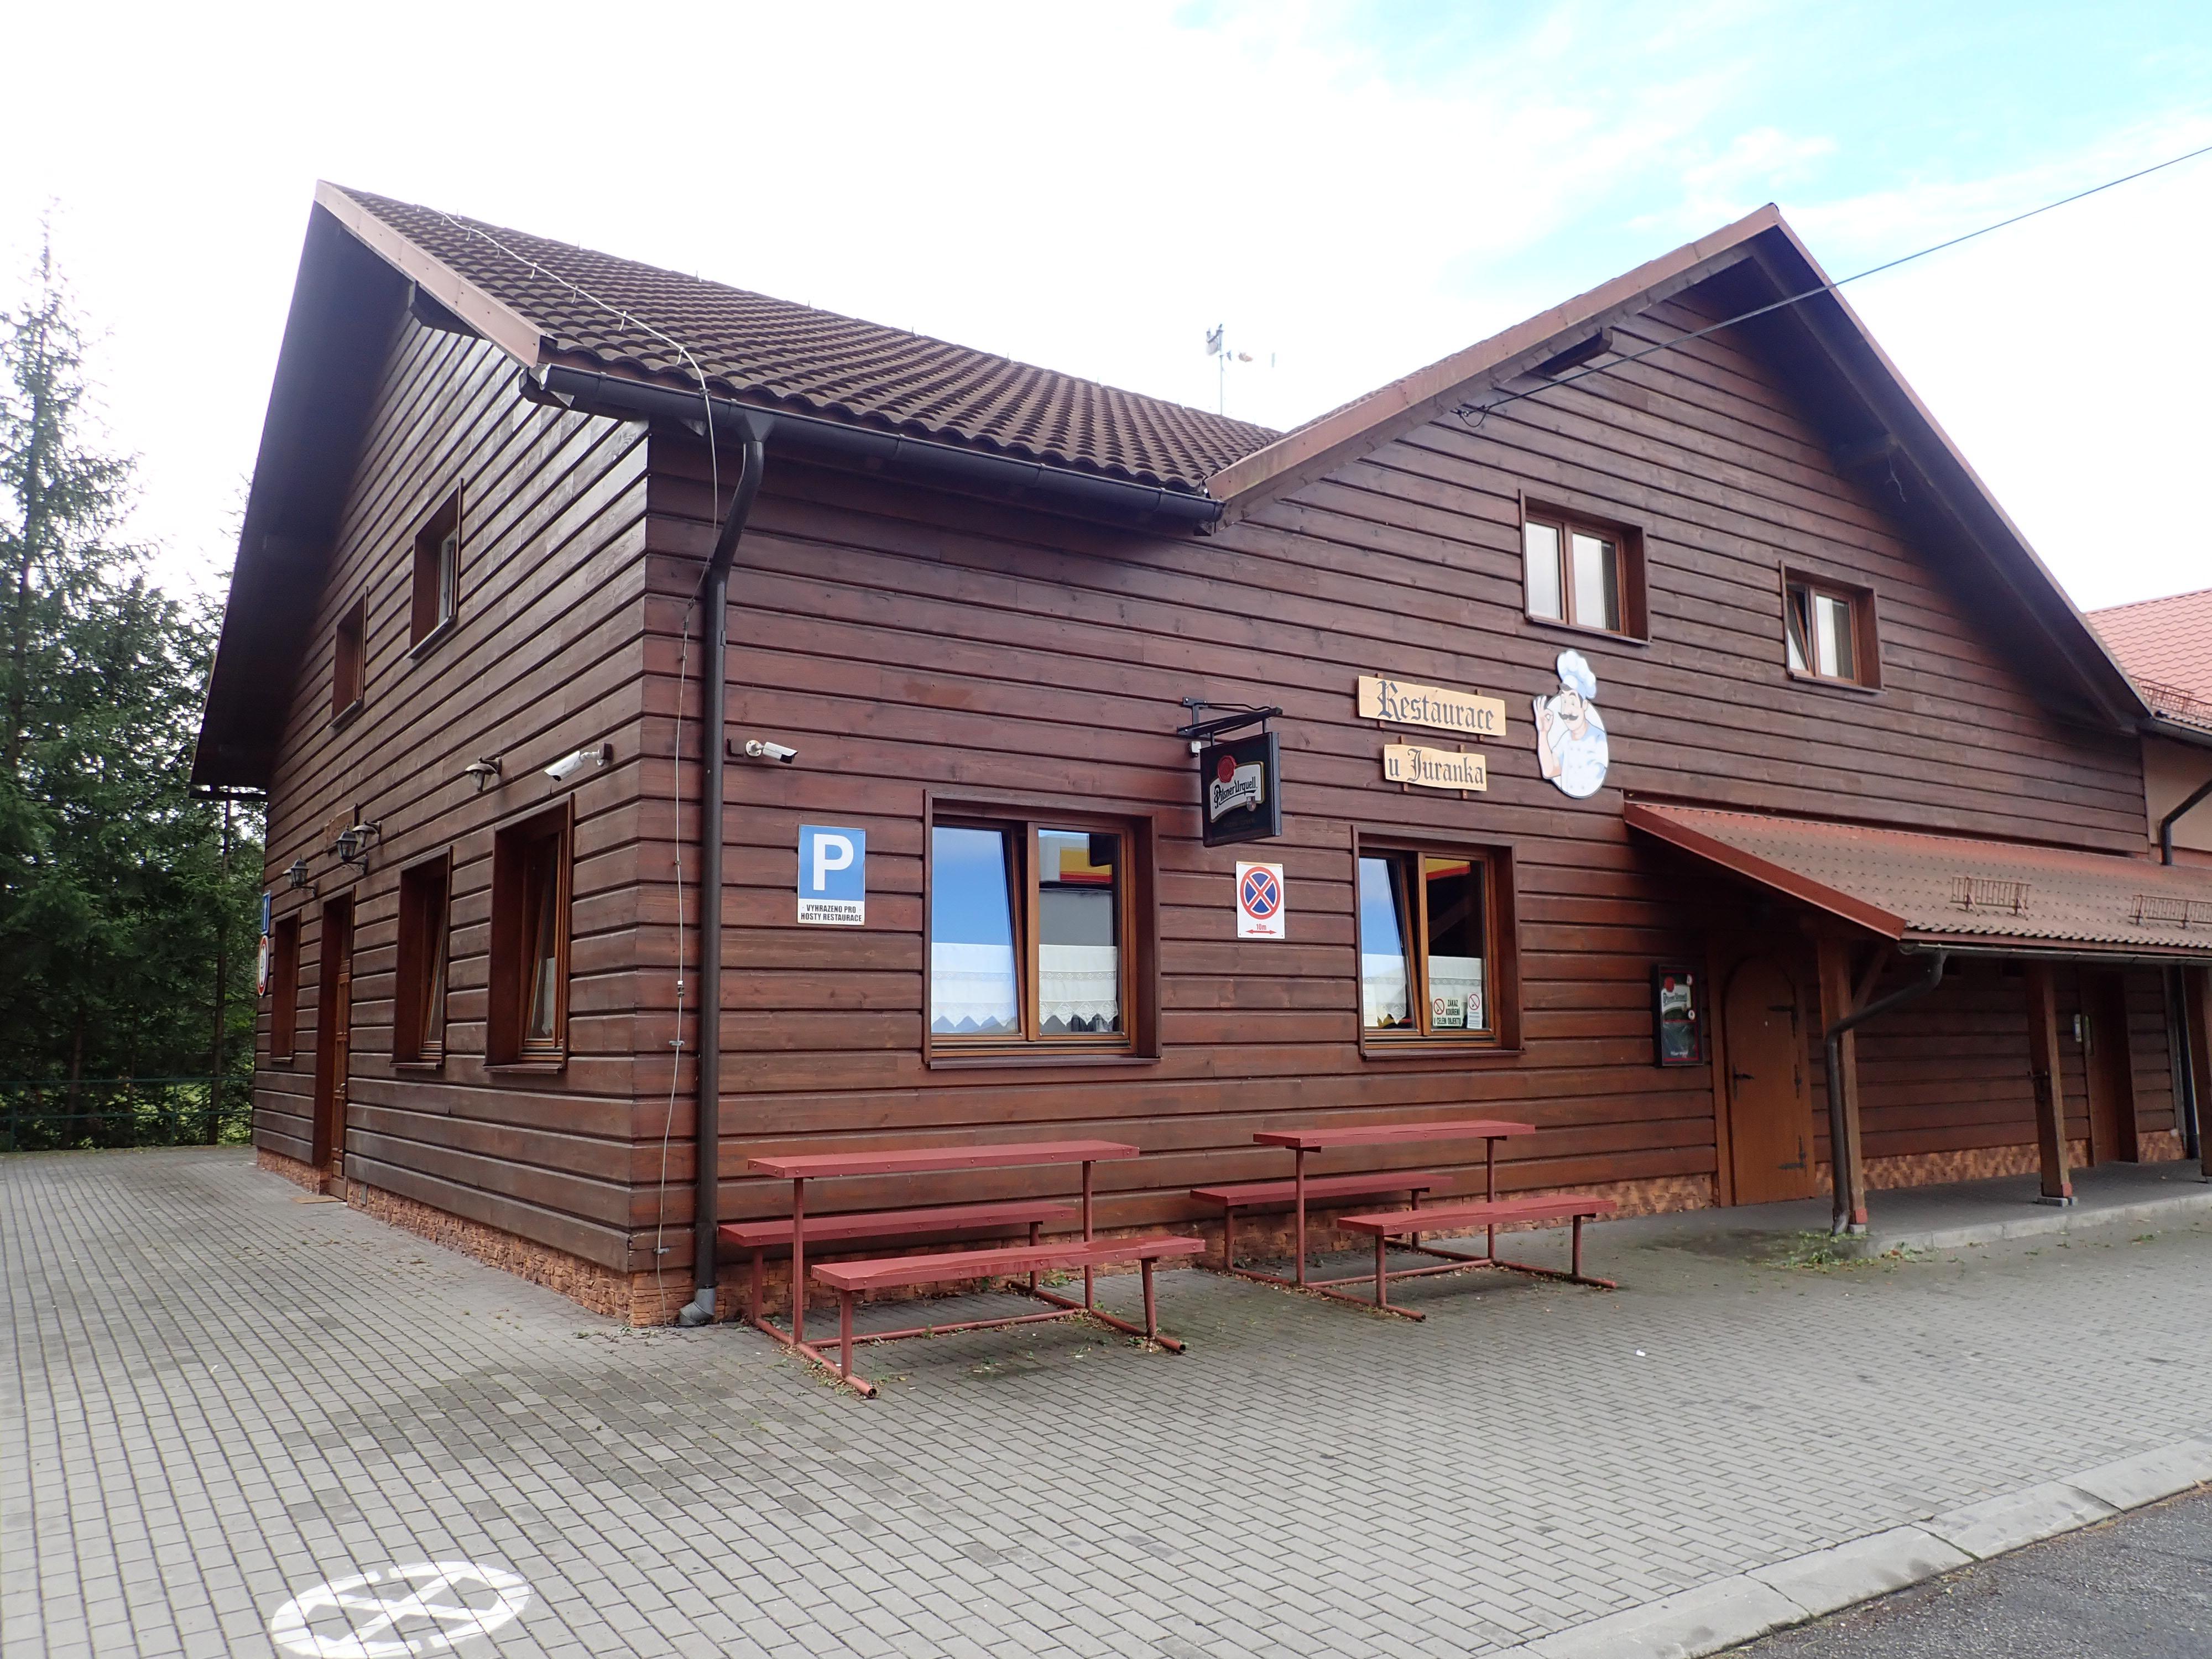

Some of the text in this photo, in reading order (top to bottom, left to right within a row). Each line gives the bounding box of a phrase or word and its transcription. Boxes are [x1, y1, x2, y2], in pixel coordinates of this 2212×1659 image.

[1376, 680, 1494, 731] Restaurace
[1388, 748, 1484, 785] u Juranka
[1214, 776, 1256, 809] Pilsner Urquell
[813, 833, 854, 891] P
[806, 904, 842, 912] VYHRAZENO
[823, 914, 862, 922] RESTAURACE
